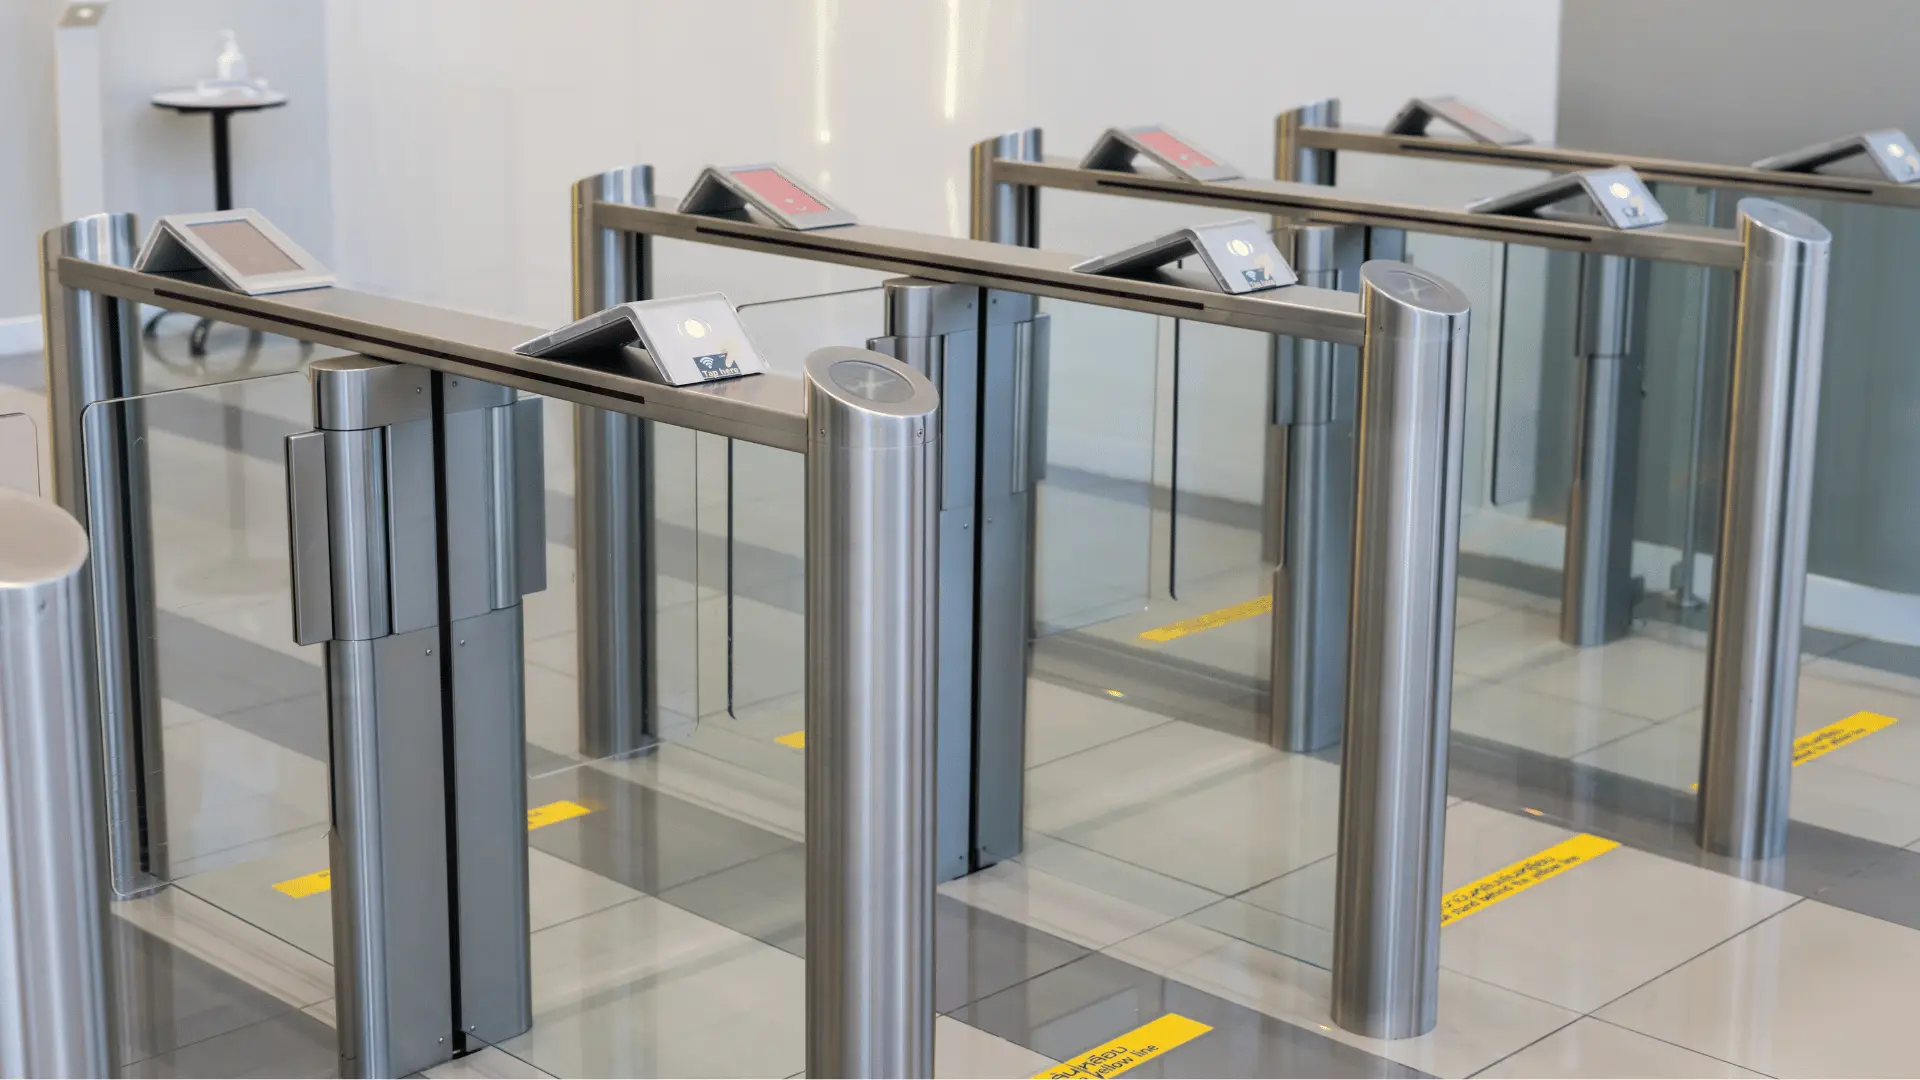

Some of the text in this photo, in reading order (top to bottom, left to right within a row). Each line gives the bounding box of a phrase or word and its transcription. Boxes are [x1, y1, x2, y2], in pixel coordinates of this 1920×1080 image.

[701, 367, 739, 378] Tap here
[1095, 1043, 1159, 1079] yellow line
